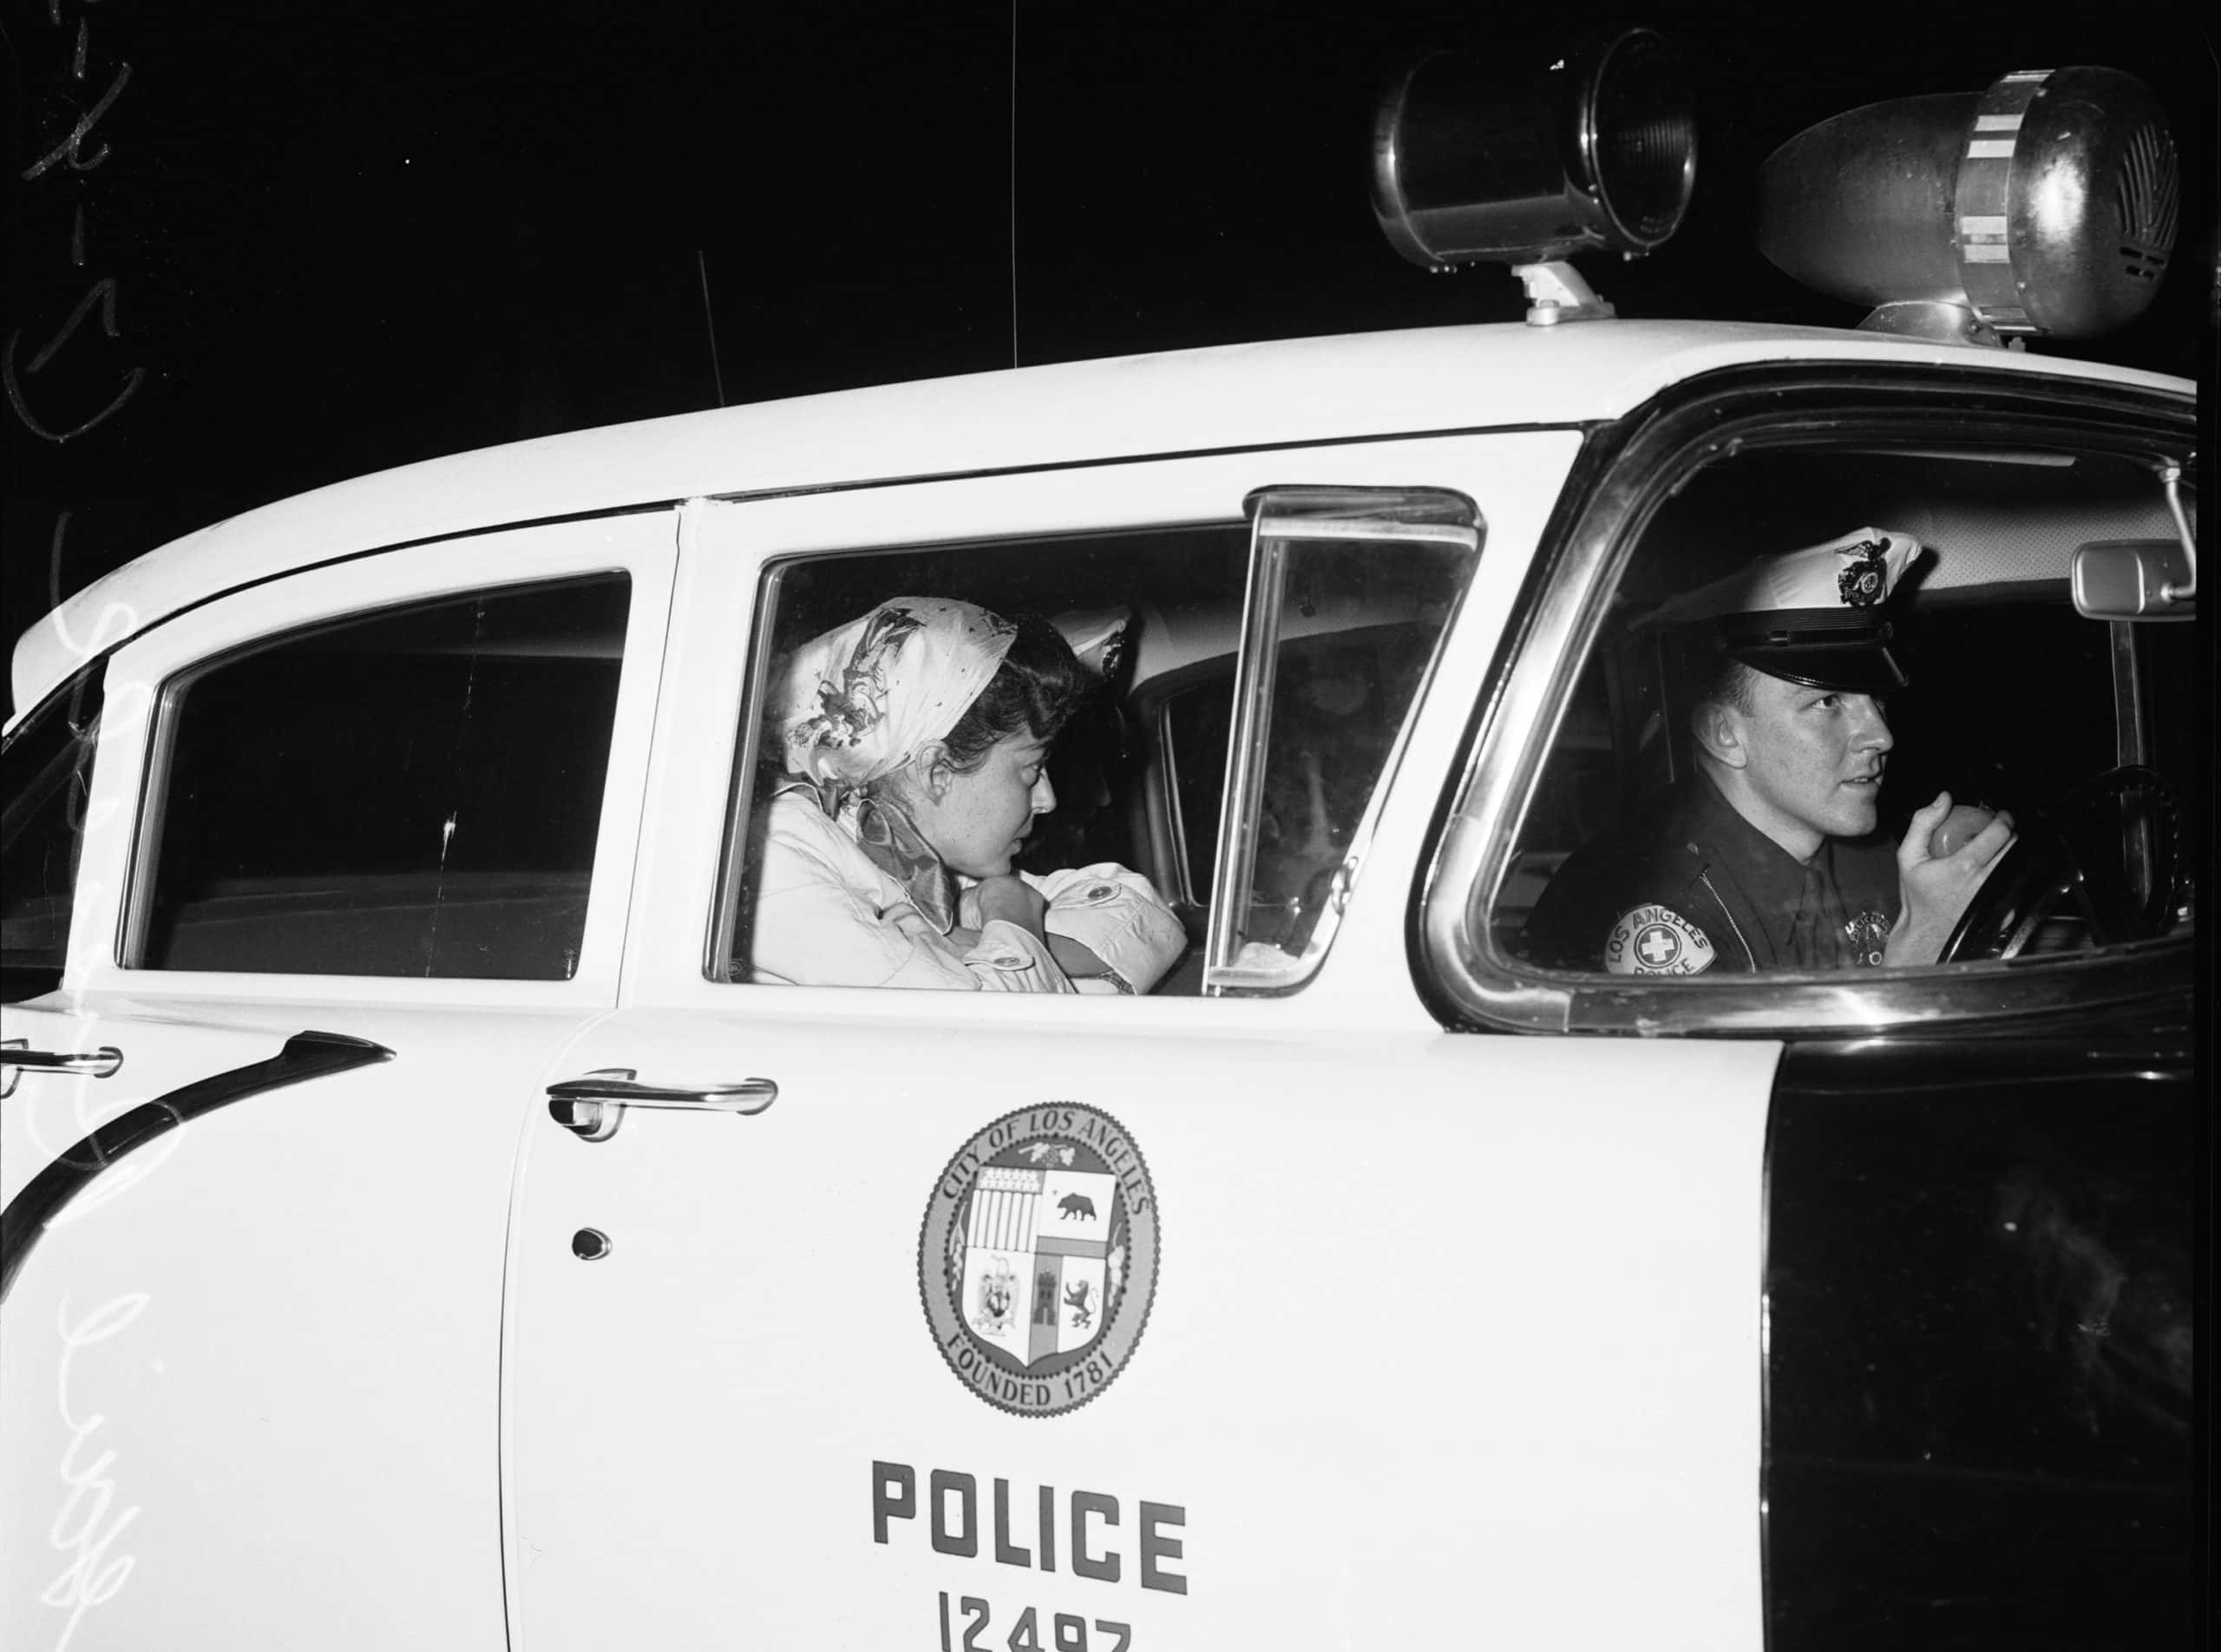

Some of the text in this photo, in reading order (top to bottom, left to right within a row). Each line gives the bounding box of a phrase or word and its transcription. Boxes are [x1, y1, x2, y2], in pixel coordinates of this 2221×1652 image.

[1609, 908, 1709, 963] LOS ANGELES
[943, 1110, 1152, 1215] CITY OF LOS ANGELES
[947, 1333, 1113, 1406] FOUNDED 1781
[872, 1459, 1189, 1596] POLICE
[938, 1590, 1132, 1652] 12497
